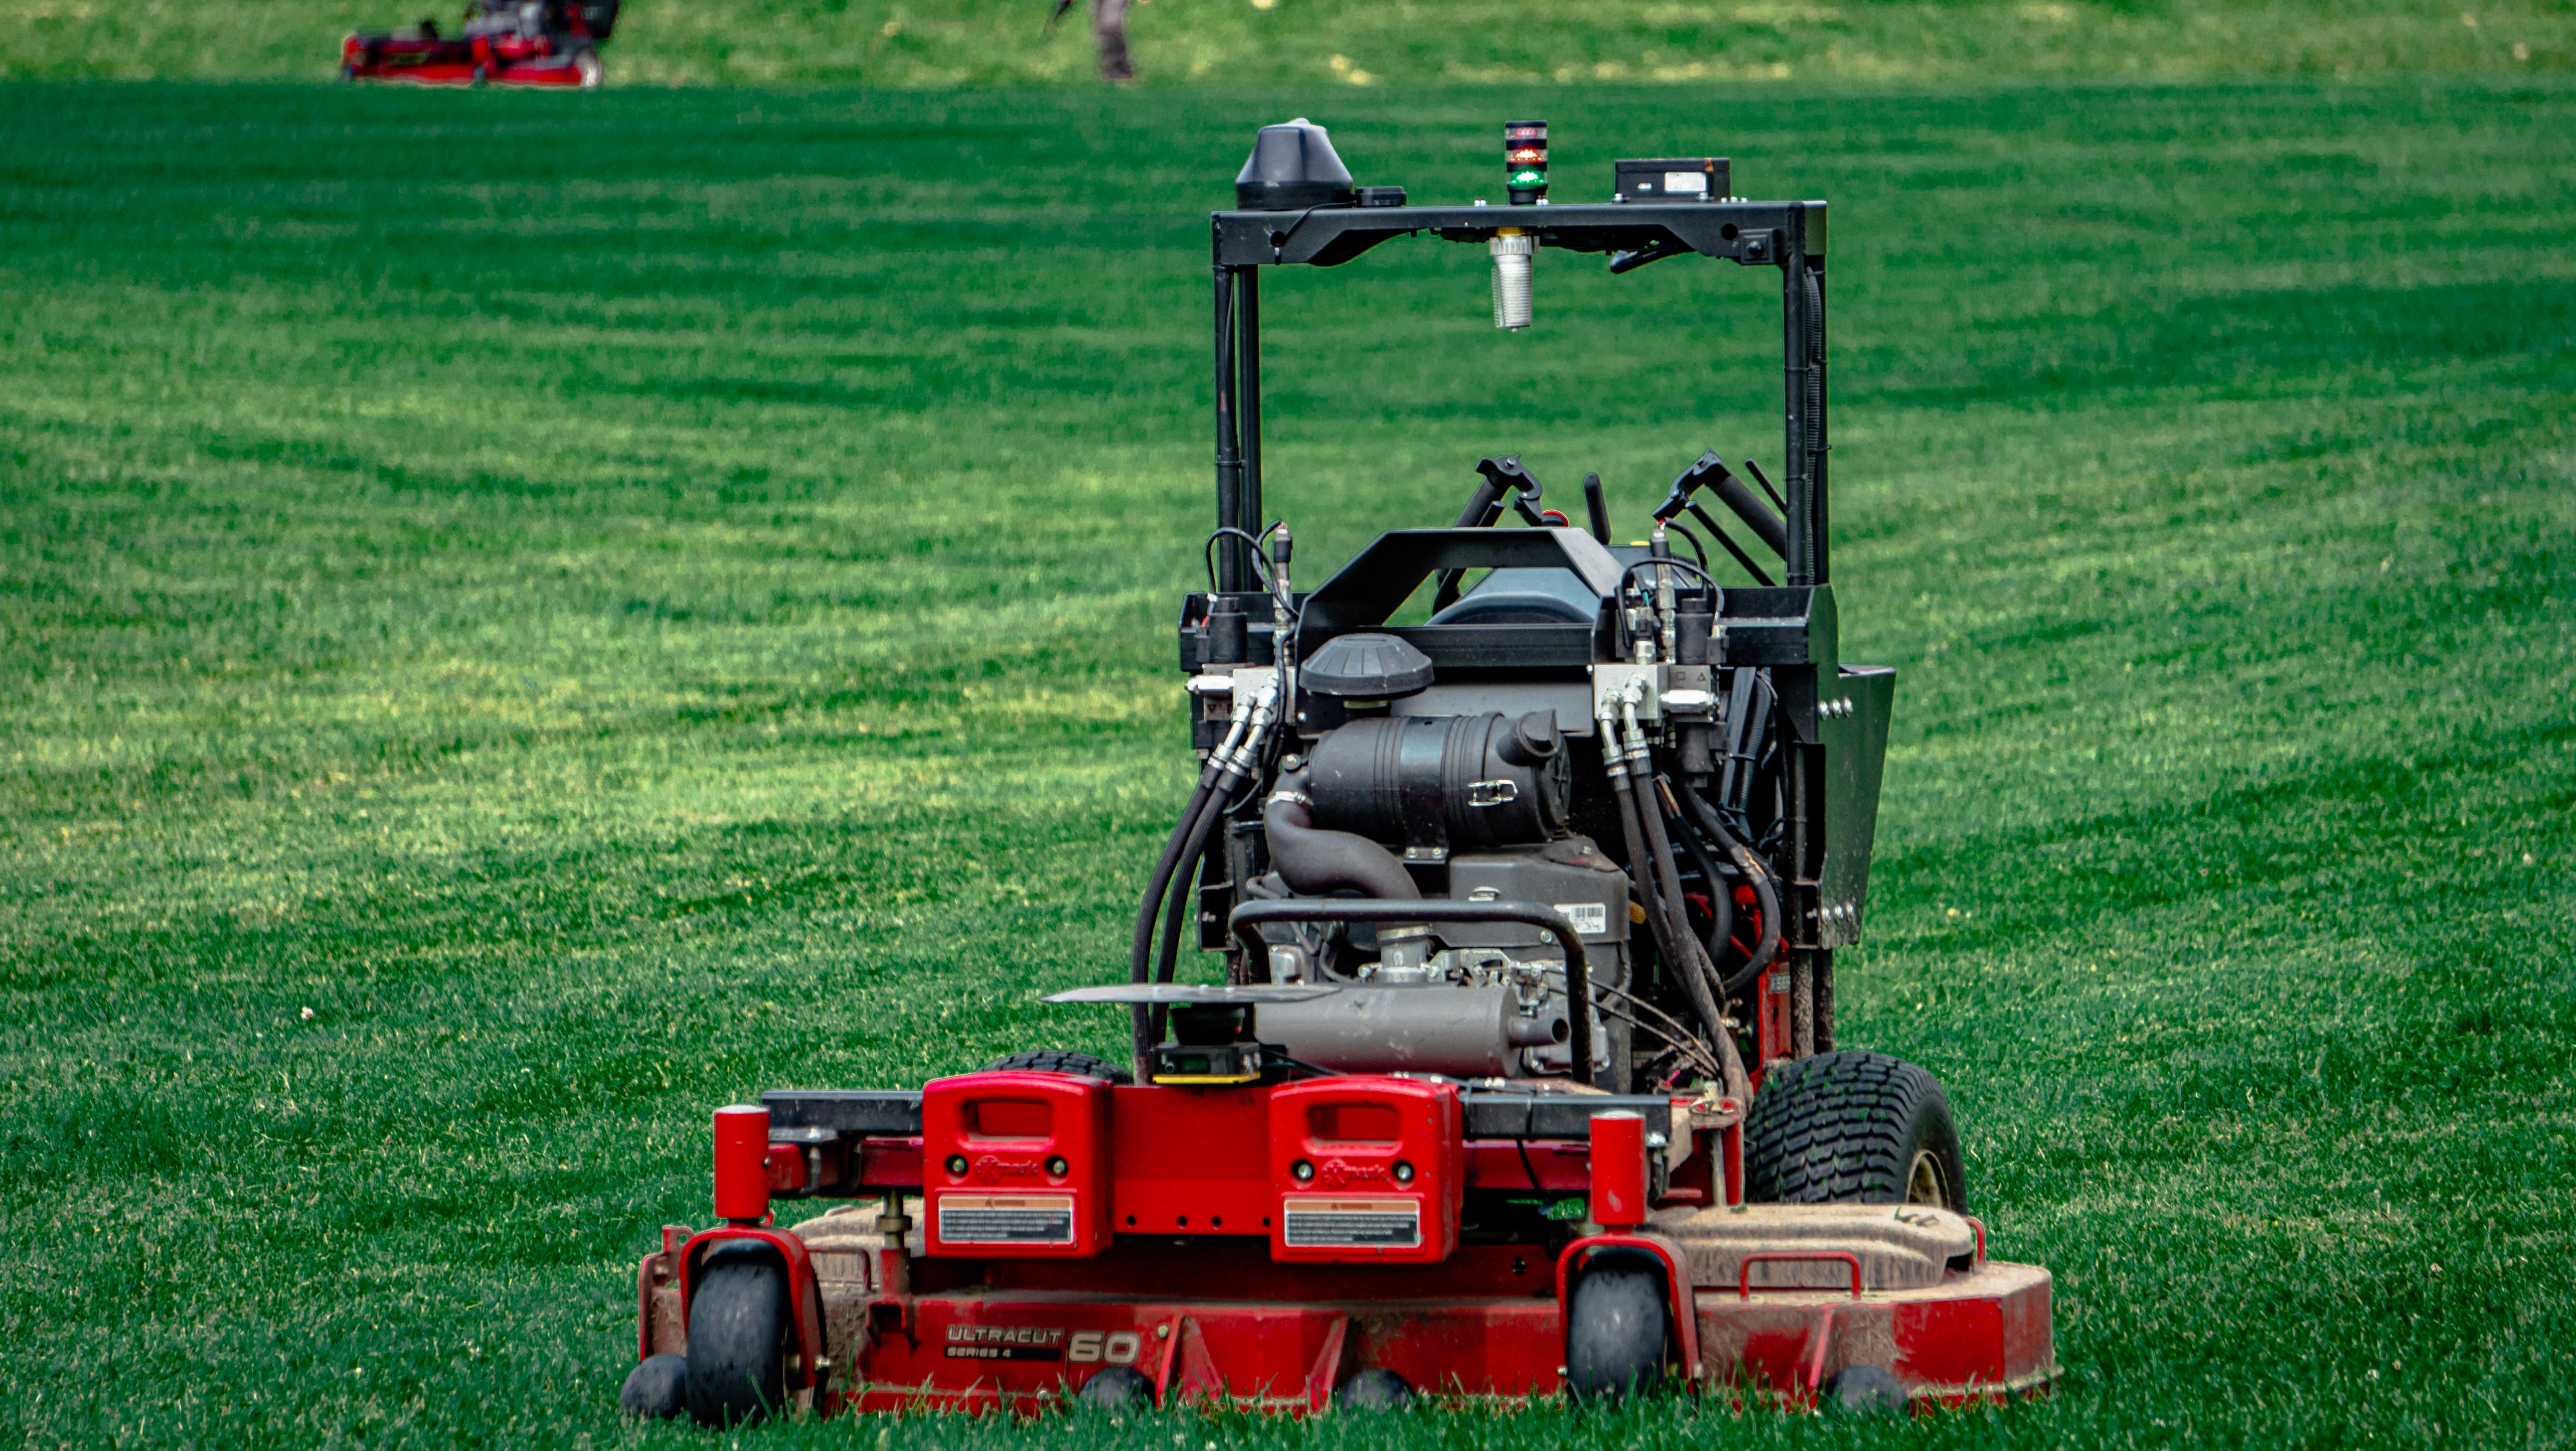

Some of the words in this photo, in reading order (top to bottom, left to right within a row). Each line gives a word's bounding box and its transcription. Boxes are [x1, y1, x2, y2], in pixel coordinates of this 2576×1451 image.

[947, 1325, 1064, 1345] ULTRACUT
[1068, 1330, 1139, 1364] 60
[947, 1346, 998, 1358] SERIES
[1002, 1348, 1012, 1358] 4
